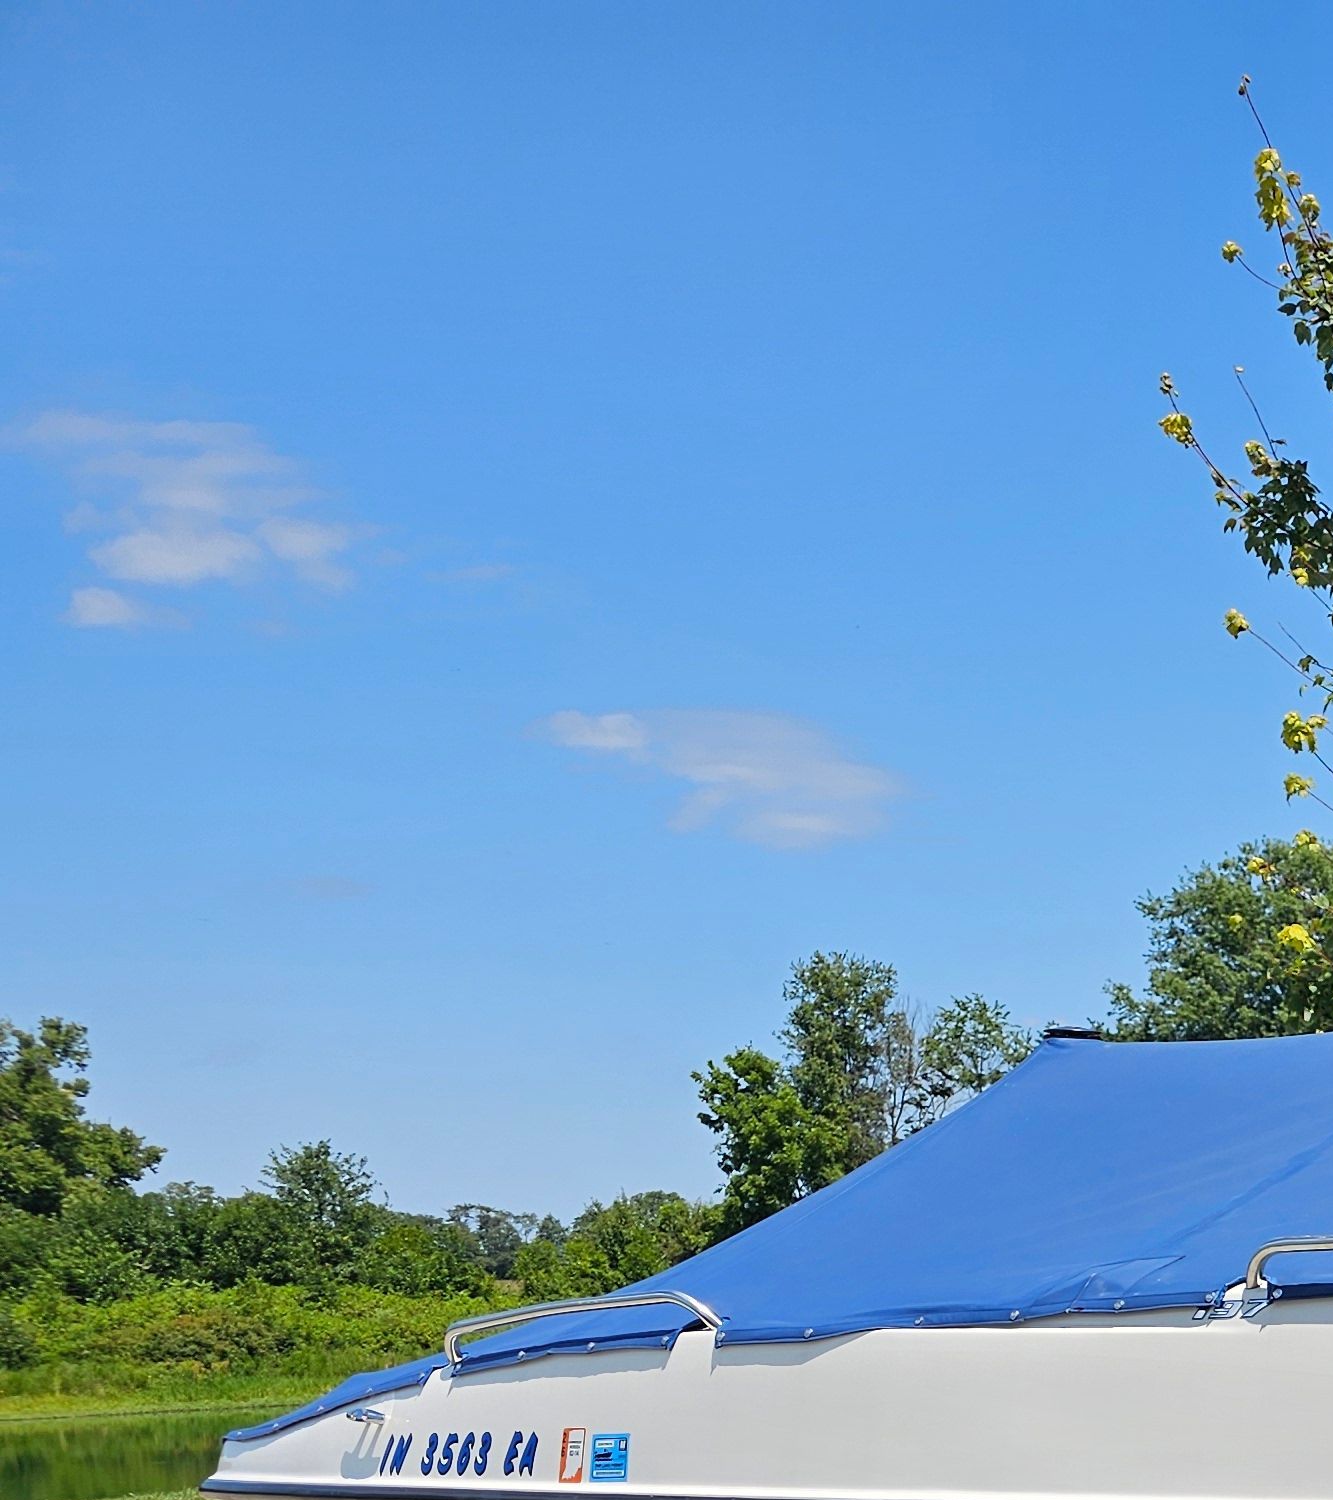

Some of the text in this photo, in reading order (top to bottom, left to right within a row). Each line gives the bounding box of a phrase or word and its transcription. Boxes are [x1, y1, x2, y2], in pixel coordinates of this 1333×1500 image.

[380, 1431, 538, 1476] IN 3563 EA
